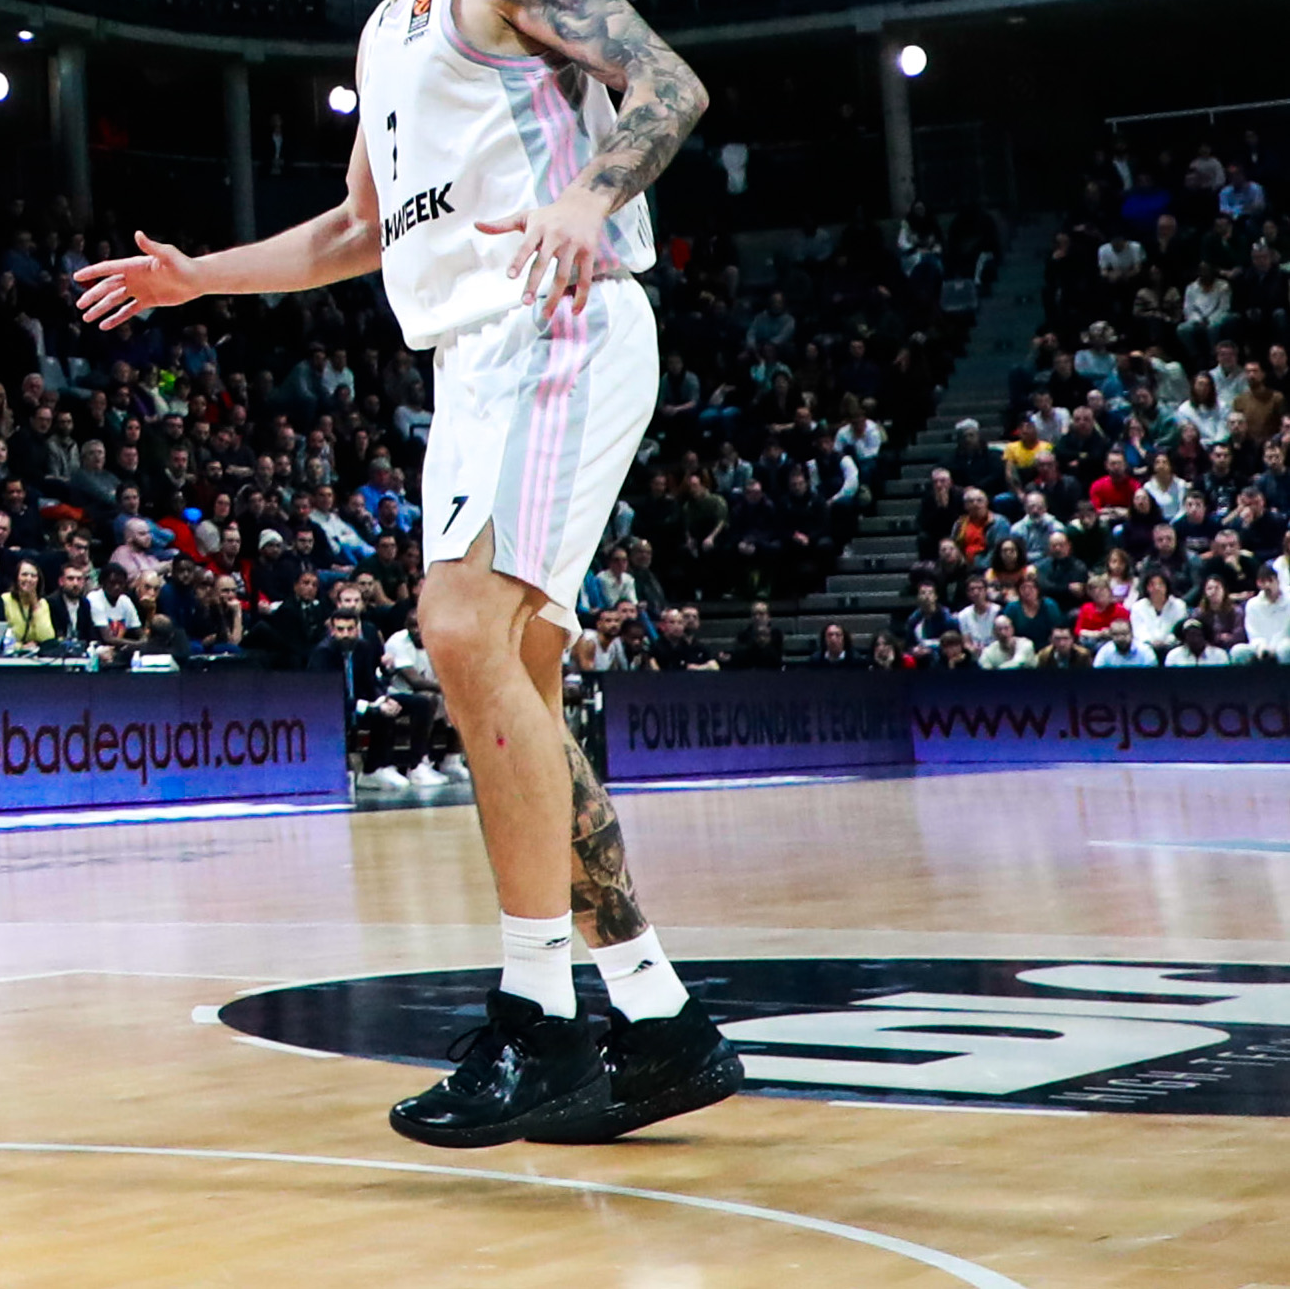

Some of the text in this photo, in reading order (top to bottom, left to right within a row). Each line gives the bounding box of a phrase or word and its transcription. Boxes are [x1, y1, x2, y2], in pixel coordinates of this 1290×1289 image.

[381, 181, 456, 252] KWEEK
[627, 702, 691, 751] POUR
[697, 701, 811, 746] REJOINDRE
